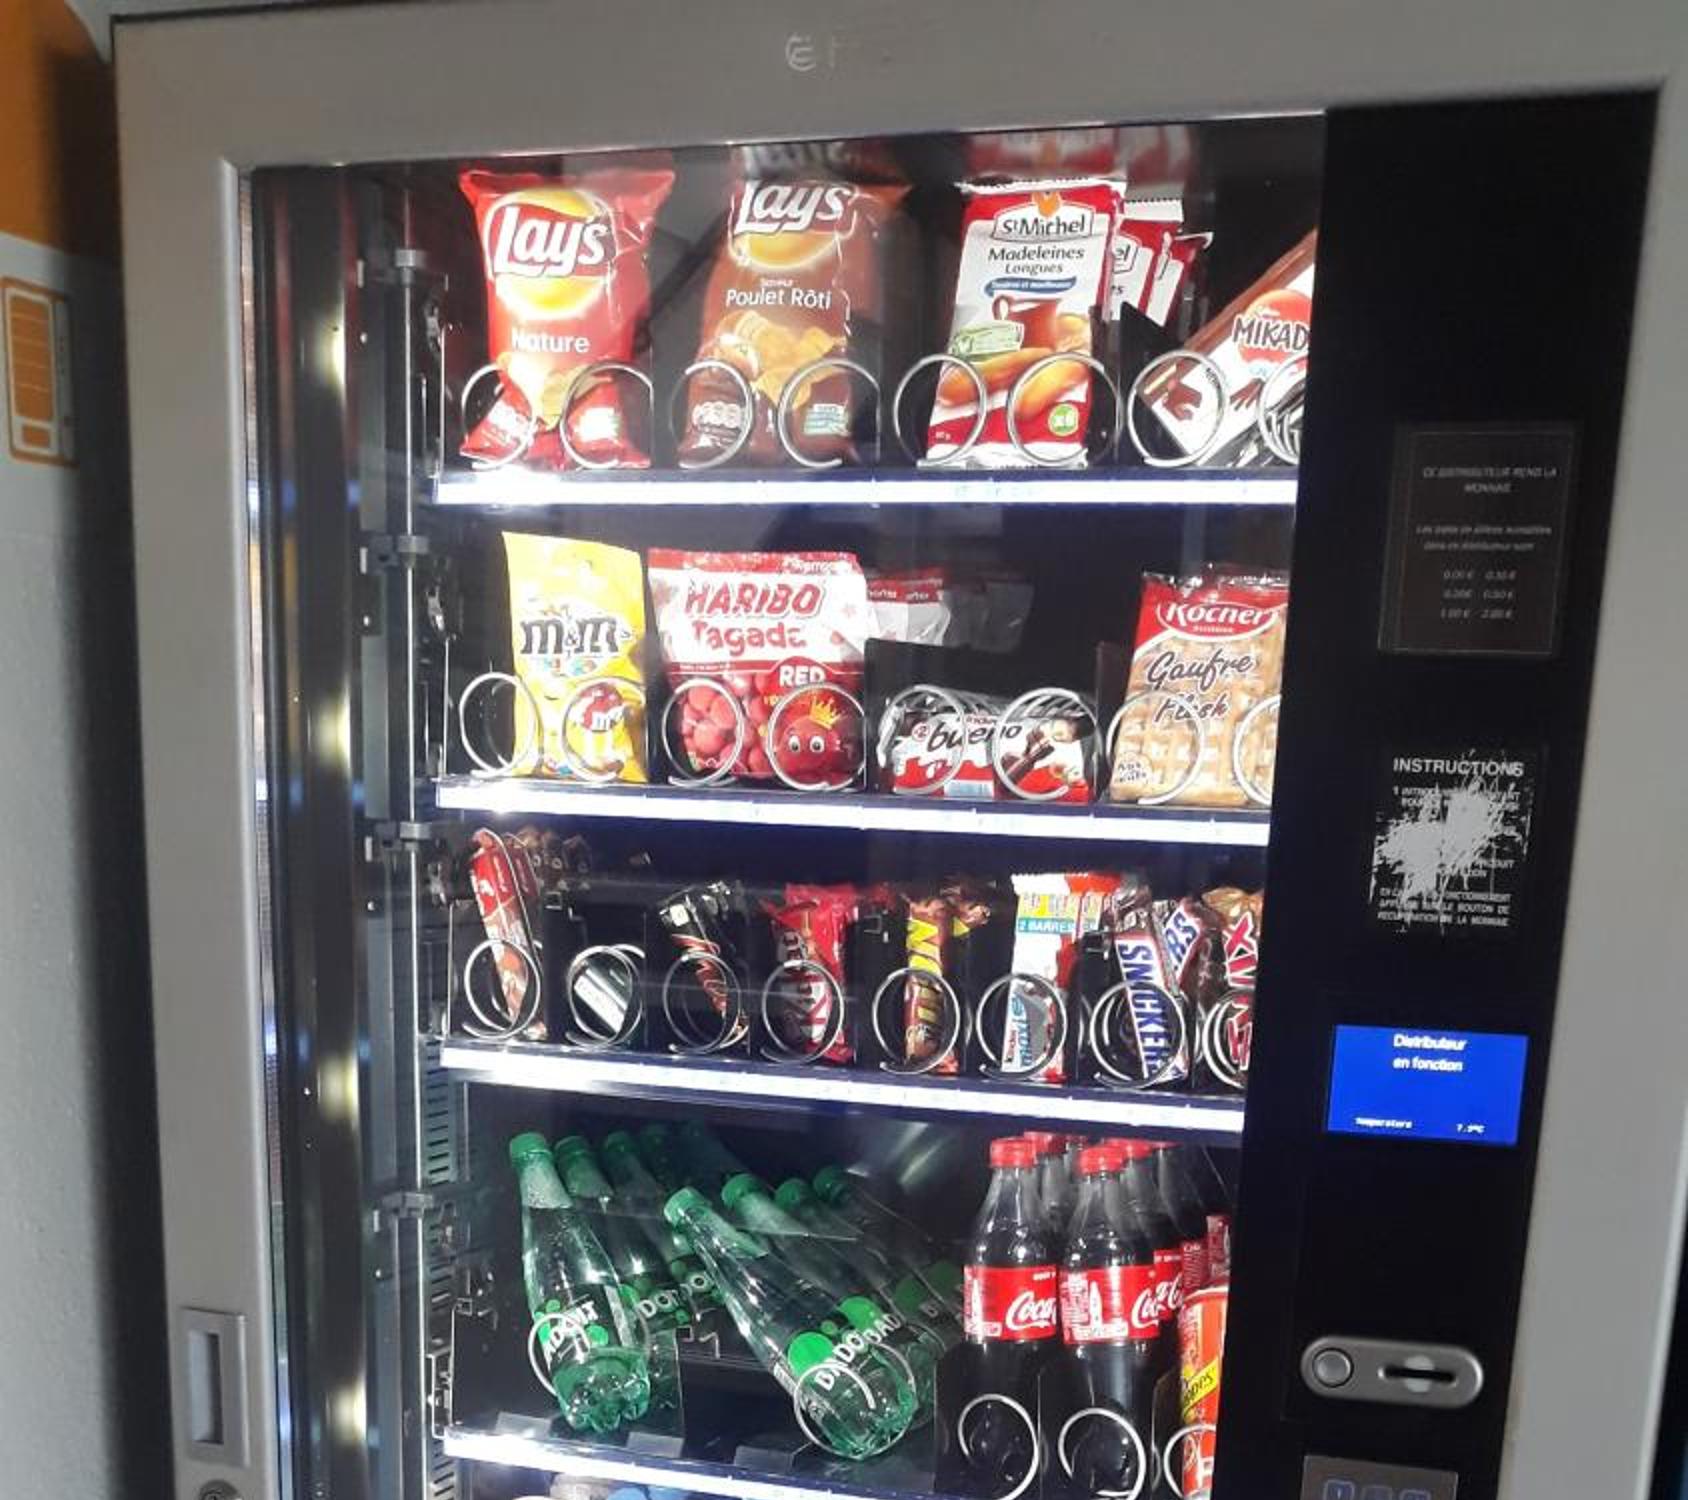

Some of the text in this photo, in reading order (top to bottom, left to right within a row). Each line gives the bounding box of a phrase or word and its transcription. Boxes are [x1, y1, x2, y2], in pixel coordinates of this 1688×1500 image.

[987, 247, 1085, 261] Madeleines
[1005, 263, 1063, 276] Longues
[726, 287, 832, 310] Poulet Rôti
[512, 328, 590, 354] Nature
[1232, 315, 1310, 351] MIKAD
[684, 583, 824, 616] HARIBO
[778, 664, 826, 687] RED
[1148, 648, 1254, 692] Gaufre
[926, 722, 1022, 751] bueno
[1393, 758, 1525, 777] INSTRUCTIONS
[1393, 1034, 1467, 1051] Distributeur
[1393, 1056, 1463, 1072] en fonction
